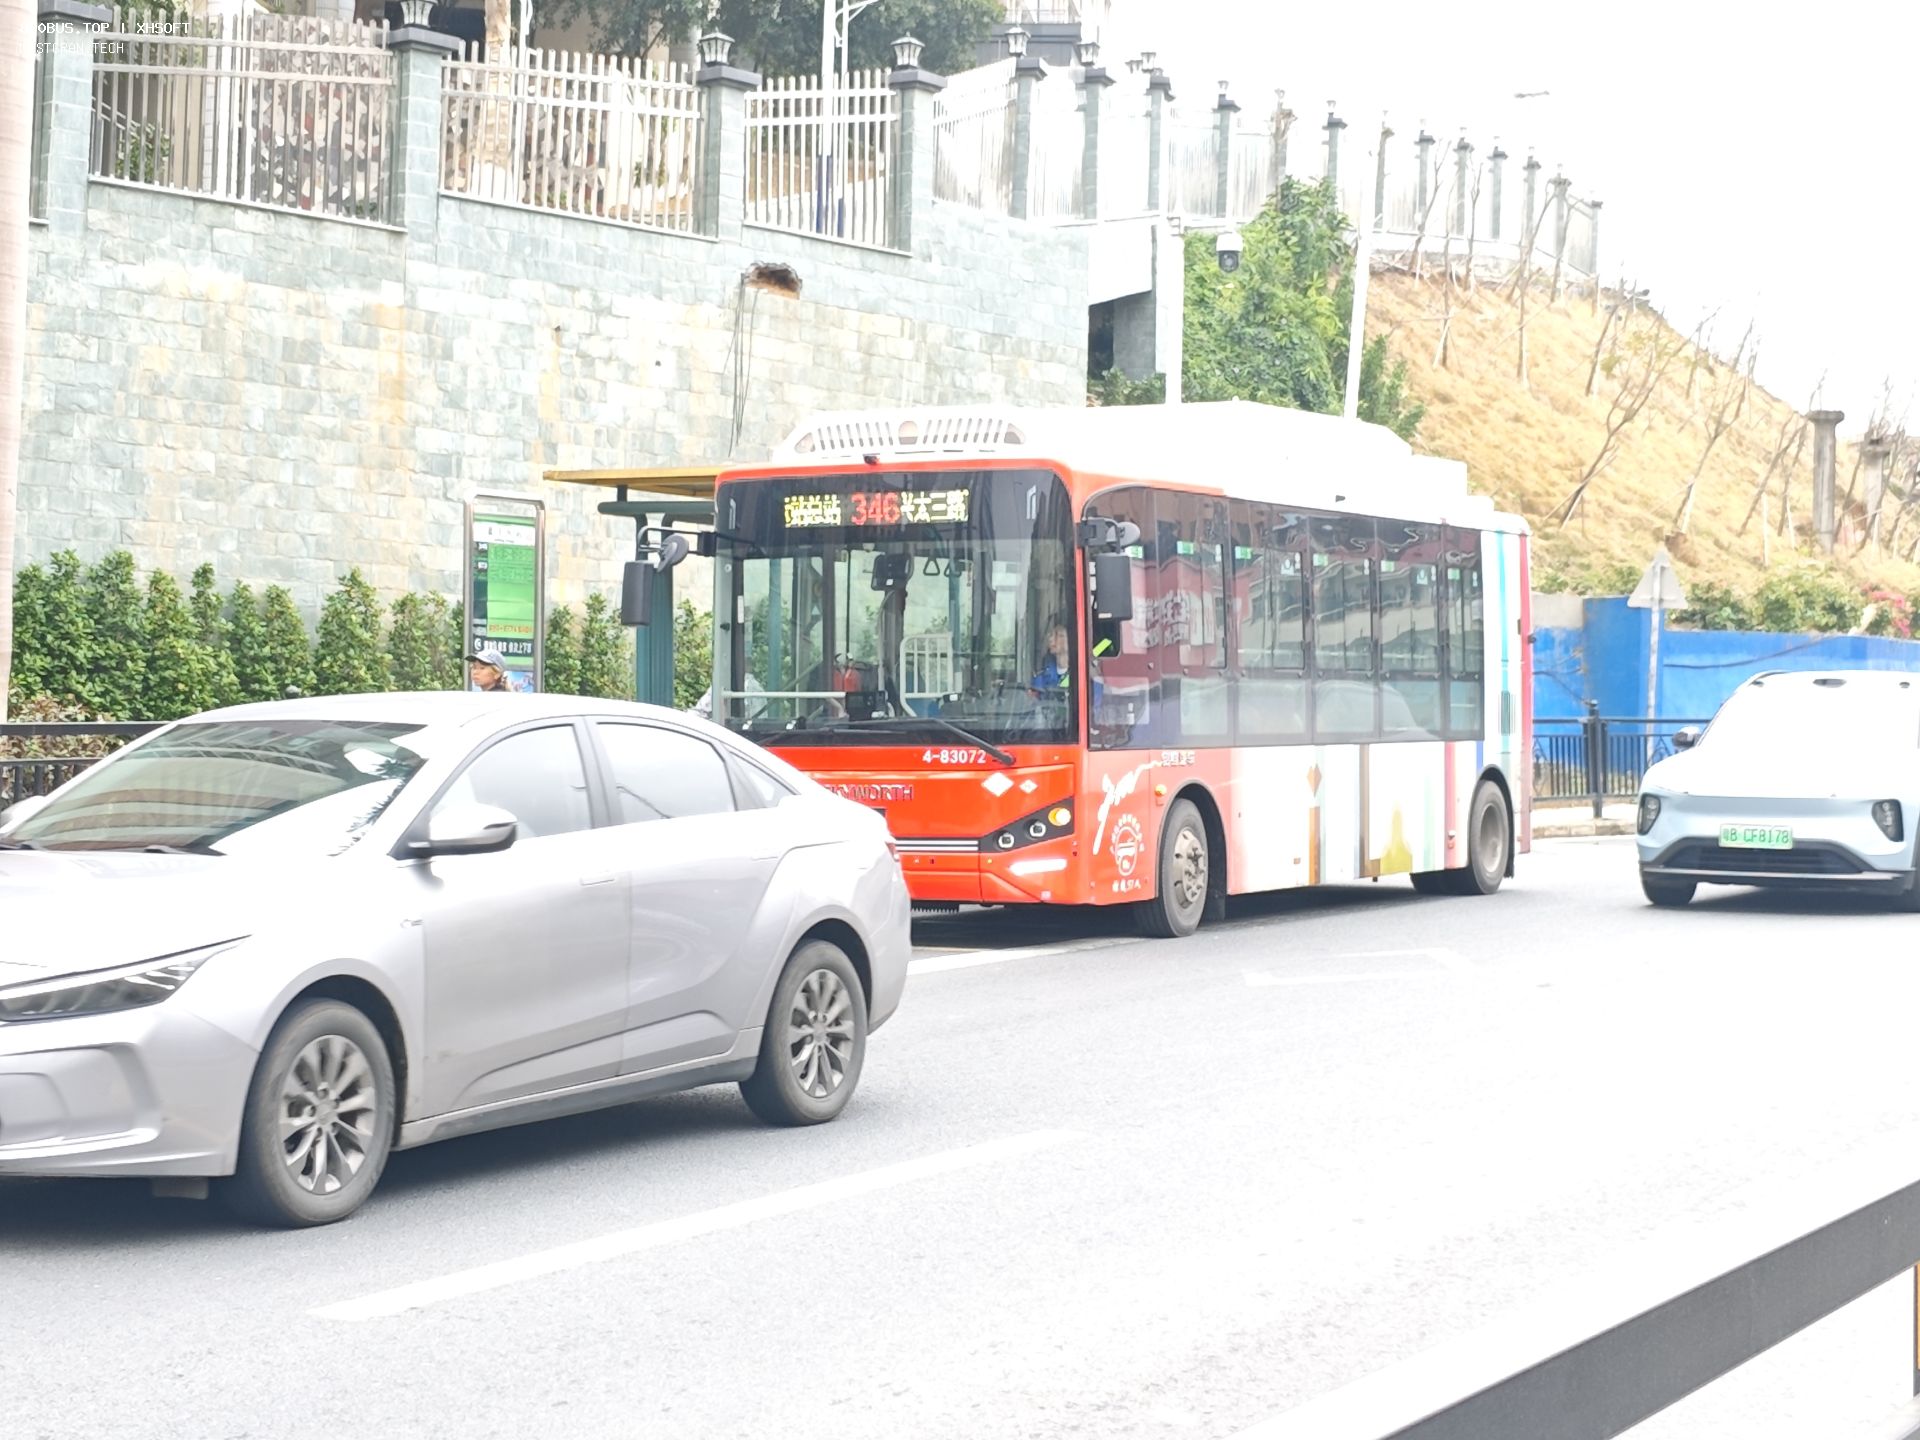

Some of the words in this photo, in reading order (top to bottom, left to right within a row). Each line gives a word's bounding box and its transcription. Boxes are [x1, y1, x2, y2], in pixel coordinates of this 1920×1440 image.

[851, 491, 900, 525] 346
[922, 750, 987, 763] 4-83072
[826, 784, 913, 801] KYWORTH
